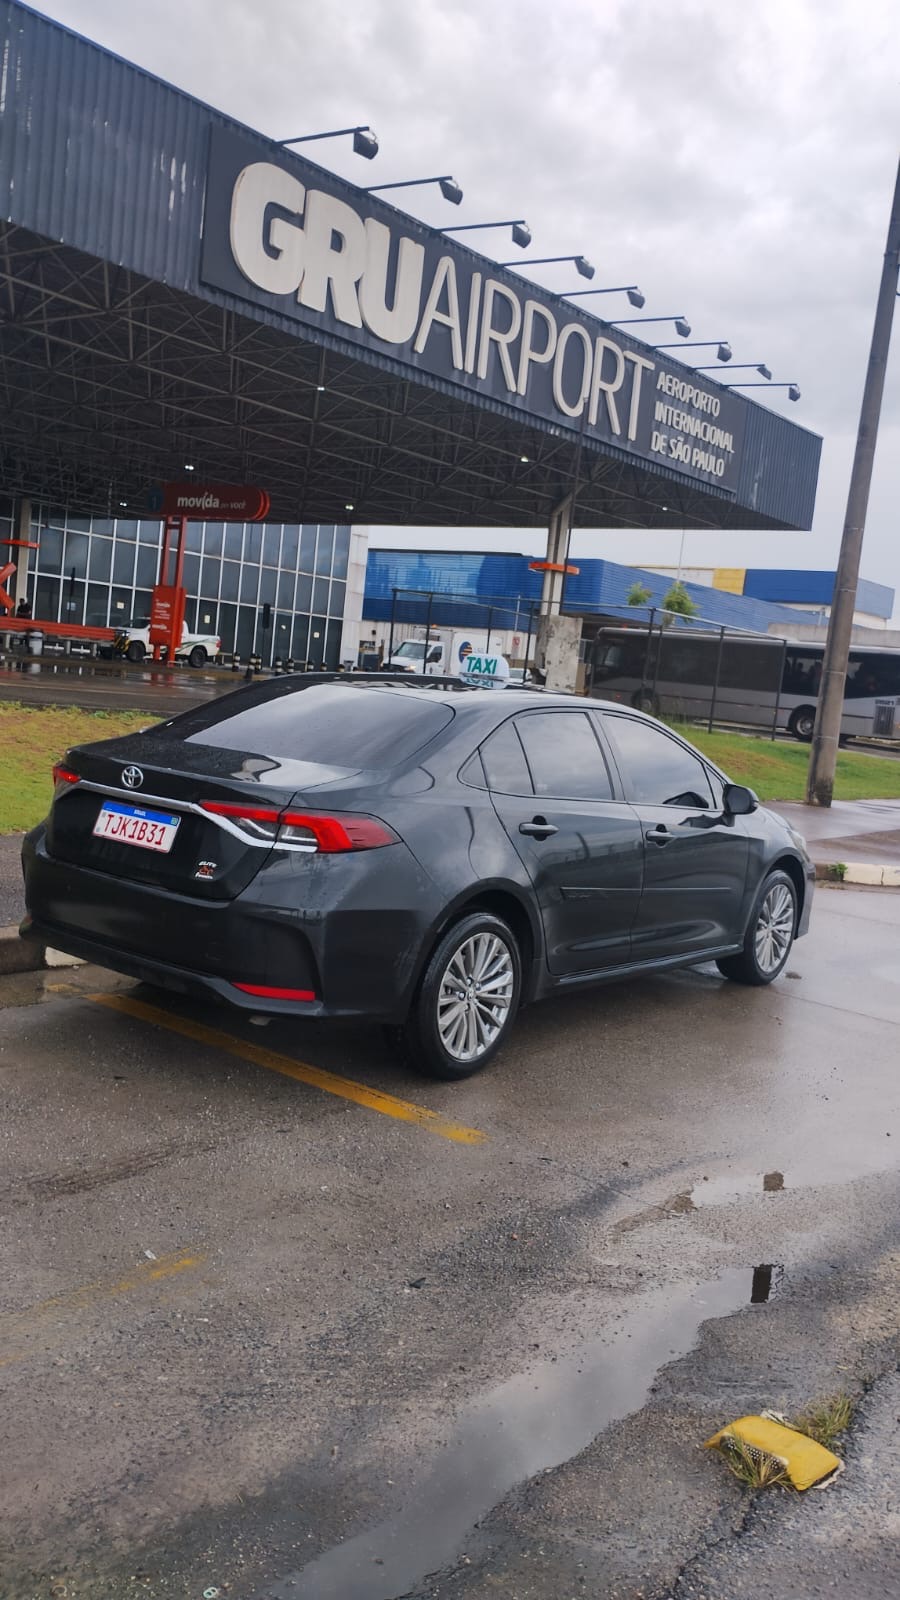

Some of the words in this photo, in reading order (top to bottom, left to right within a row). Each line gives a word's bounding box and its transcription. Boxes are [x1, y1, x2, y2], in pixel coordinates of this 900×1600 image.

[229, 161, 425, 343] GRU
[413, 255, 655, 441] AIRPORT
[656, 371, 720, 417] AEROPORTO
[654, 400, 735, 453] INTERNACIONAL
[651, 431, 667, 455] DE
[668, 436, 691, 464] SÃO
[691, 447, 724, 477] PAULO
[467, 656, 497, 674] TAXI
[104, 814, 166, 845] TJK1B31
